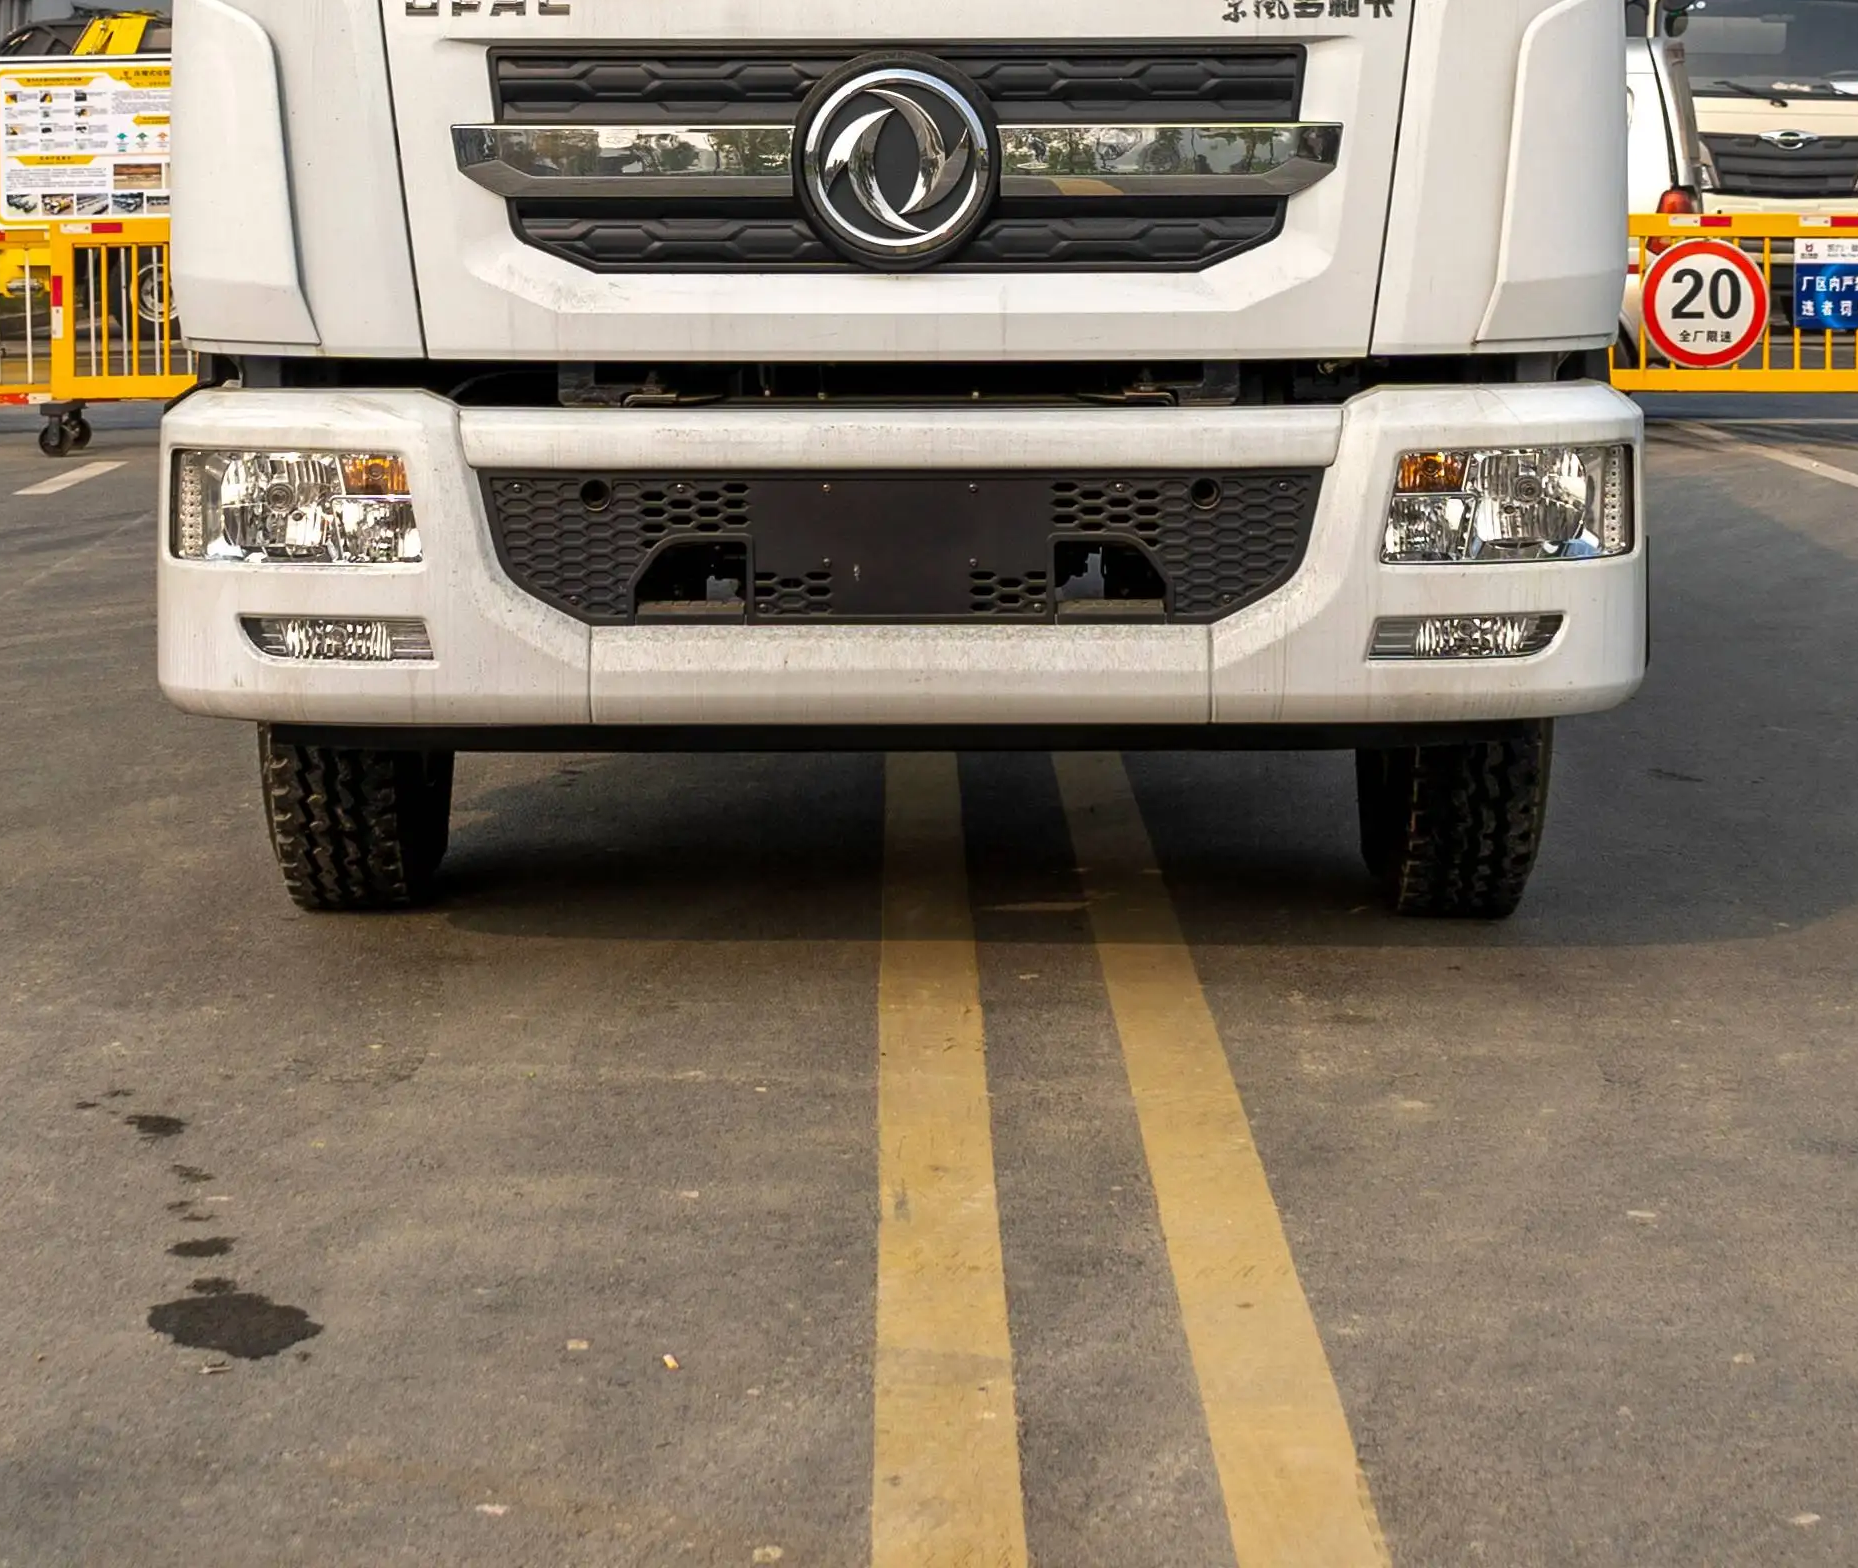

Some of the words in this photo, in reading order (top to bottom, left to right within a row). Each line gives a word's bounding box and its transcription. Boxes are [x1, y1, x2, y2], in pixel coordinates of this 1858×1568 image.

[1670, 268, 1741, 320] 20
[1679, 330, 1732, 343] 全厂限速
